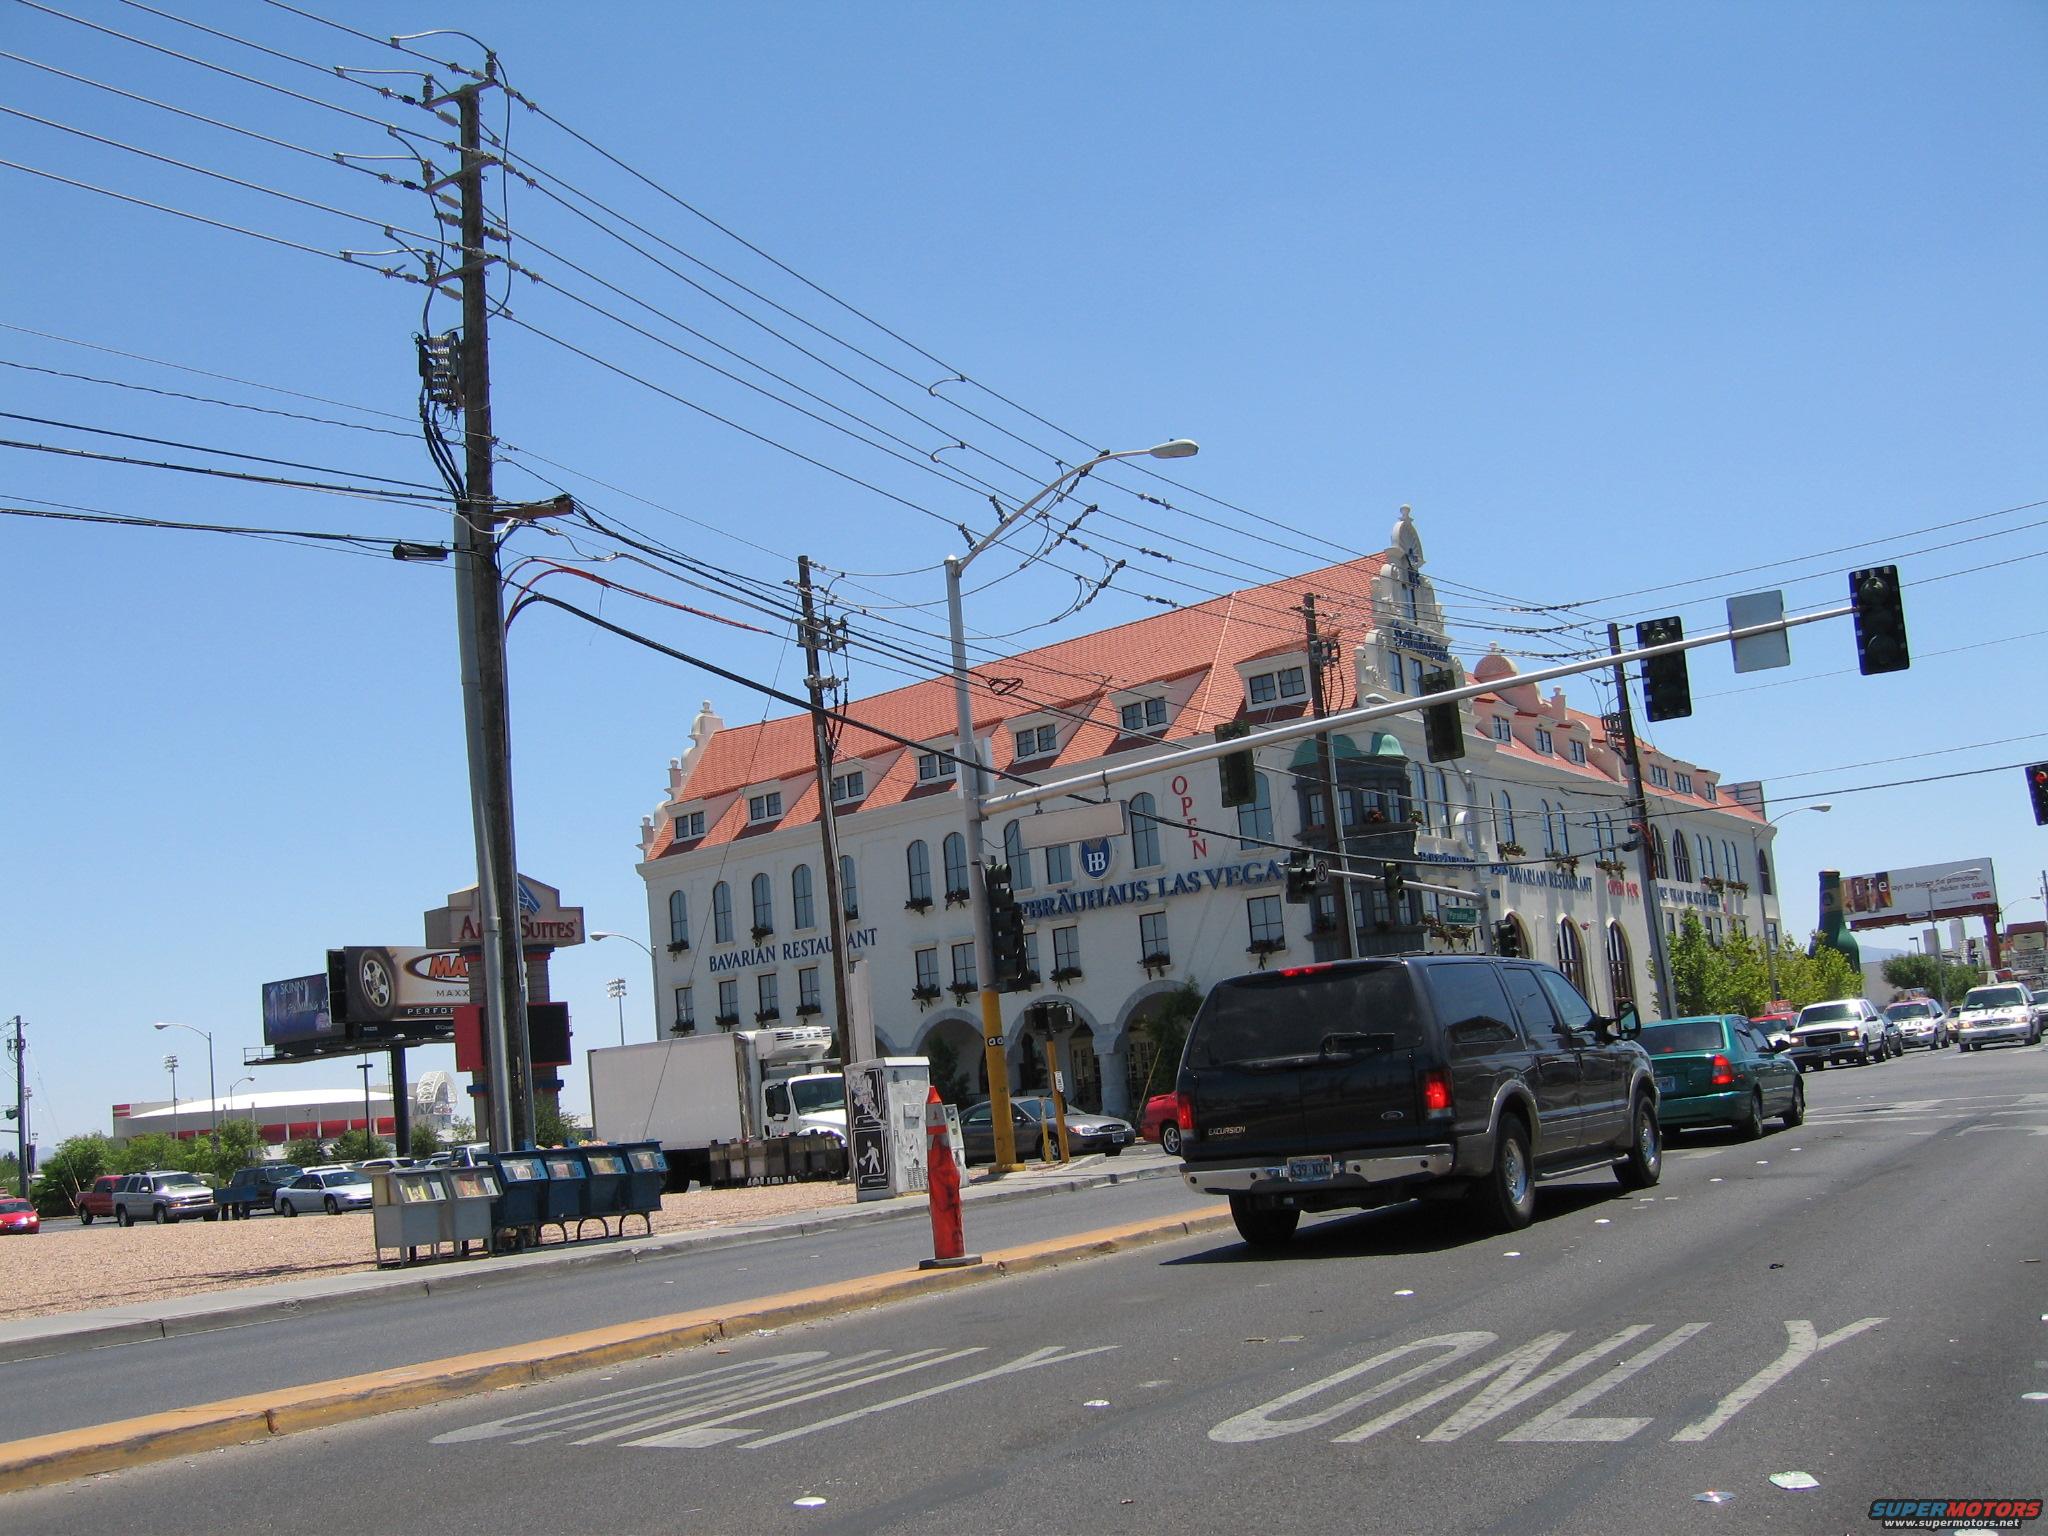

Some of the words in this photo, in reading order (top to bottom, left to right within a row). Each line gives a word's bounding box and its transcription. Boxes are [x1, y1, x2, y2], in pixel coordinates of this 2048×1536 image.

[1171, 775, 1207, 859] OPEN
[1019, 880, 1150, 918] BRÄUHAUS
[1157, 871, 1201, 898] LAS
[1203, 858, 1289, 890] VEGA
[1508, 866, 1547, 887] BAVARIAN
[1843, 877, 1888, 898] life
[428, 955, 469, 977] MA
[709, 945, 776, 972] BAVARIAN
[783, 928, 878, 960] RESTAUANT
[1208, 1126, 1246, 1136] EXCURSION
[428, 1345, 1122, 1449] ONLY
[1207, 1317, 1891, 1443] ONLY
